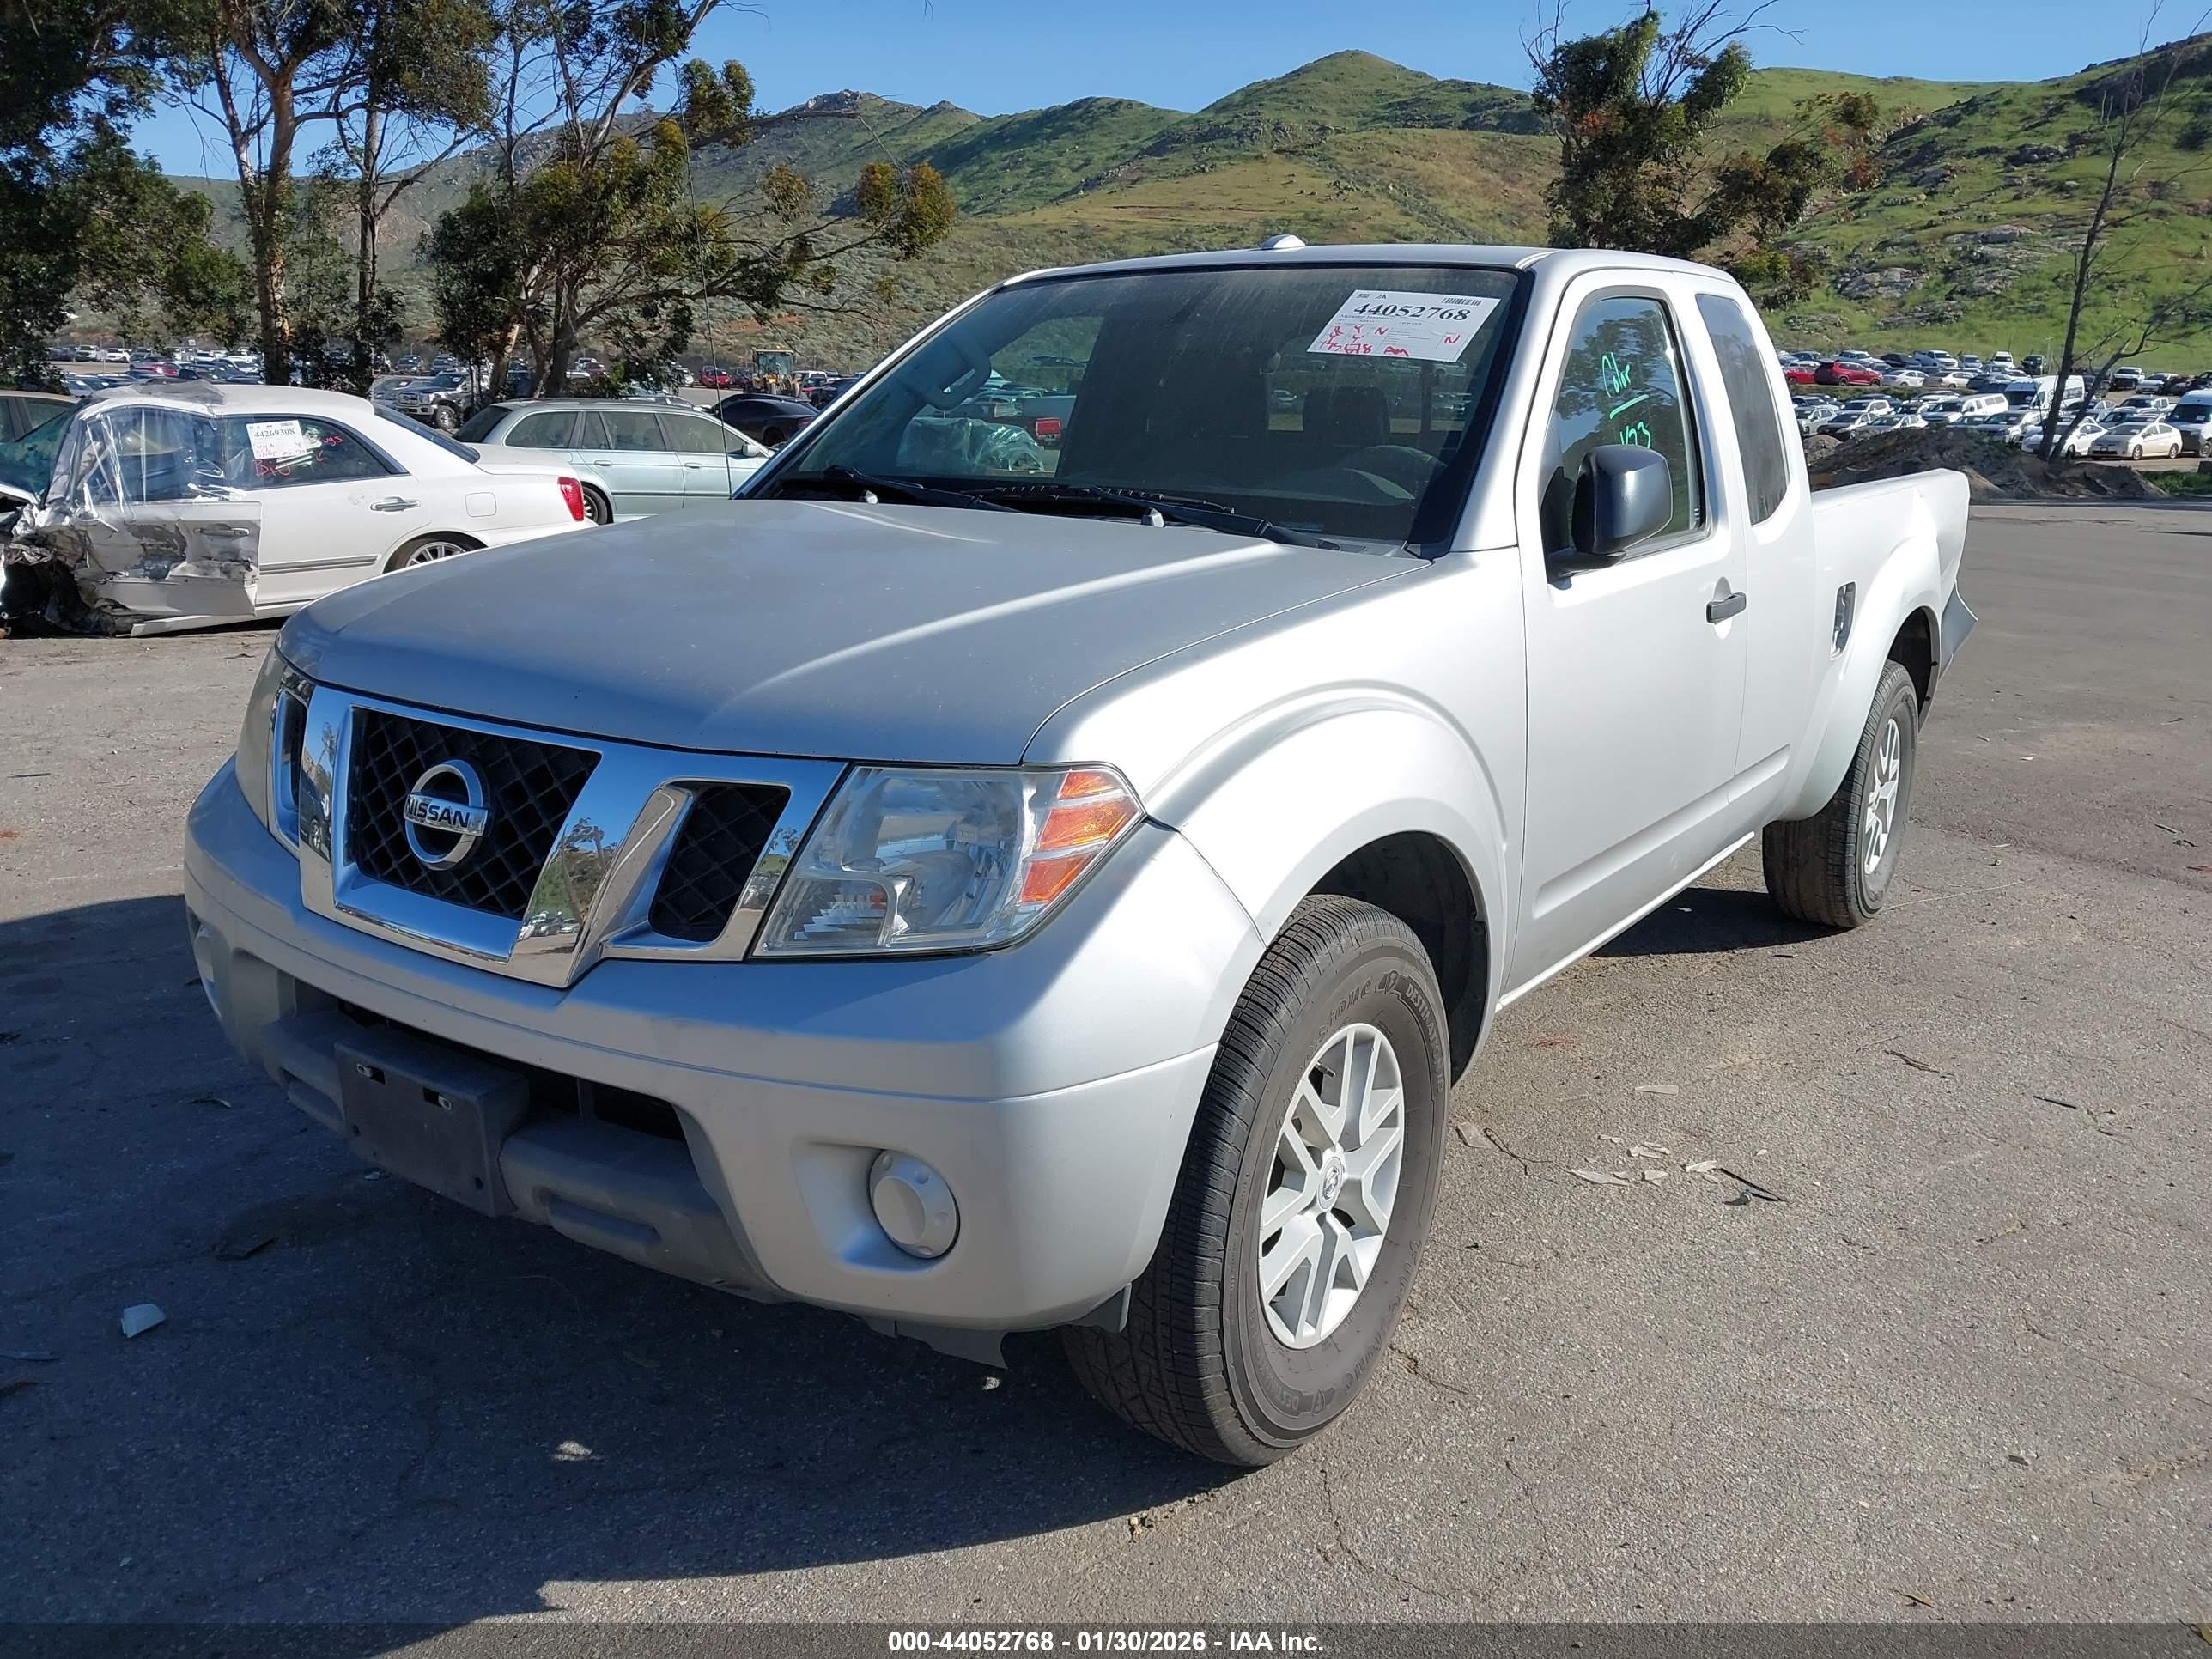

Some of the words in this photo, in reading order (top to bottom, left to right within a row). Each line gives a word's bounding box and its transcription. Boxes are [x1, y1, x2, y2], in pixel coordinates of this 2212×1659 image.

[1353, 303, 1471, 321] 44052768
[254, 428, 295, 438] 44269308
[405, 796, 470, 828] NISSAN
